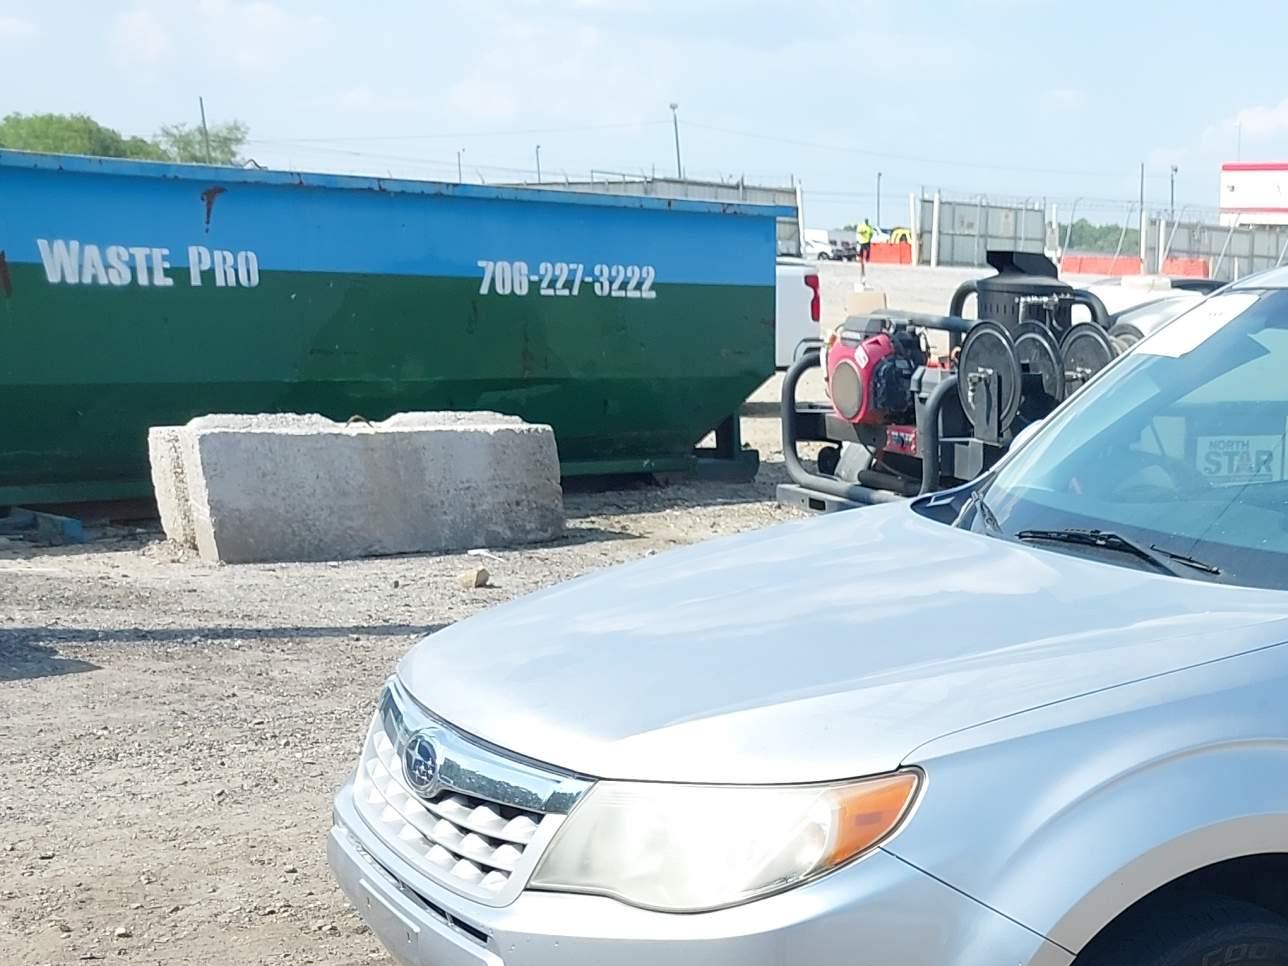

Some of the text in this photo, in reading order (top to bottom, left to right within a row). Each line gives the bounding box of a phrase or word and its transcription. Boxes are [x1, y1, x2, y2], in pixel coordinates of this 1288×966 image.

[36, 238, 260, 288] WASTE PRO
[477, 260, 657, 299] 706-227-3222
[1208, 440, 1249, 451] NORTH
[1202, 449, 1274, 475] STAR
